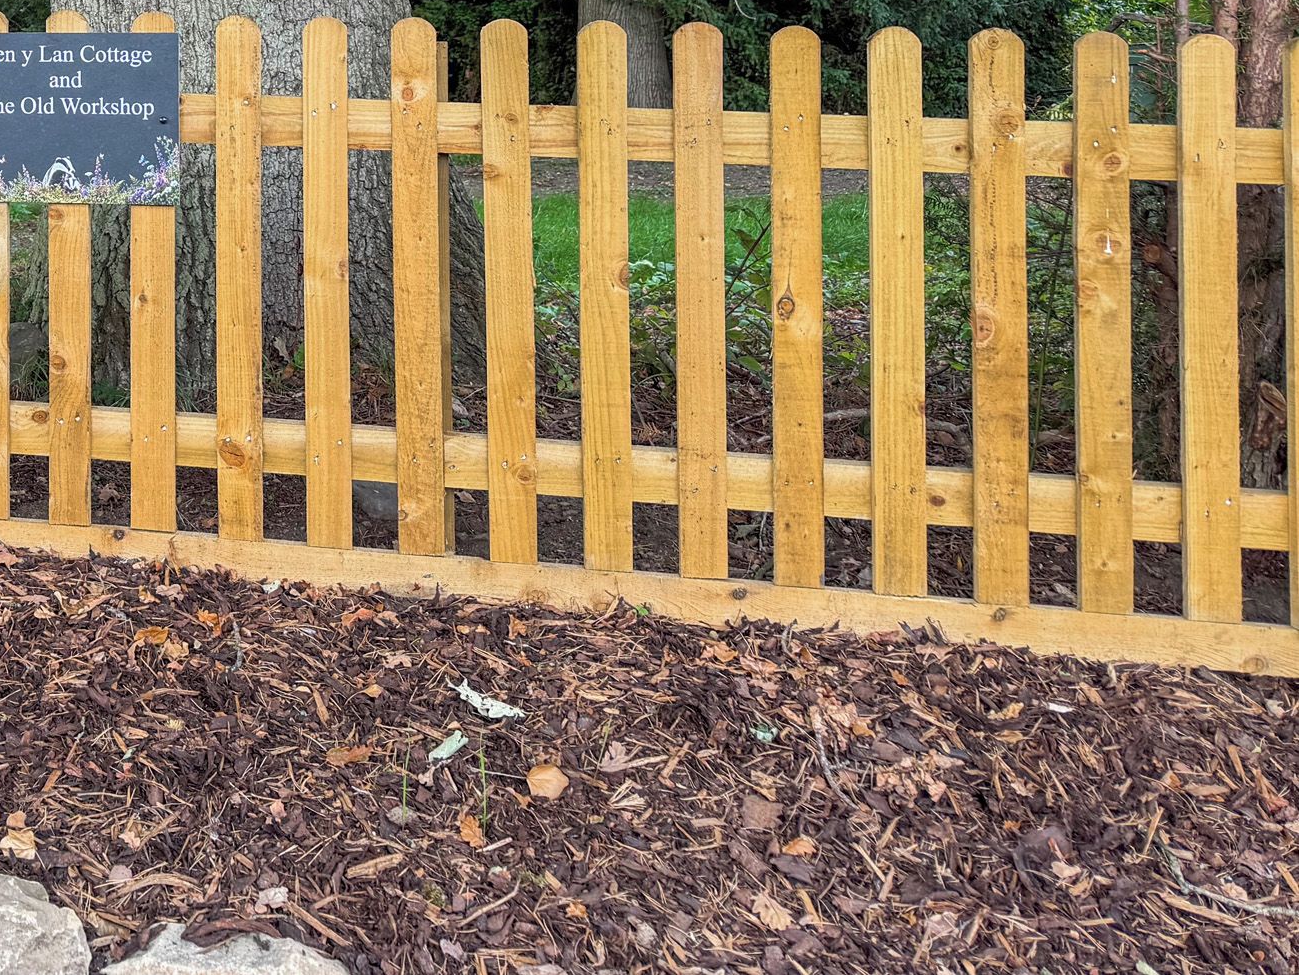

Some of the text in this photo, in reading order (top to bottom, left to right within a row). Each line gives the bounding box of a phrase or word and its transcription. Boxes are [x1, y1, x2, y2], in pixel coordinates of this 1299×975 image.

[21, 50, 33, 67] y
[38, 45, 74, 63] Lan
[80, 45, 152, 67] Cottage
[49, 71, 82, 88] and
[20, 96, 54, 114] Old
[60, 97, 154, 120] Workshop
